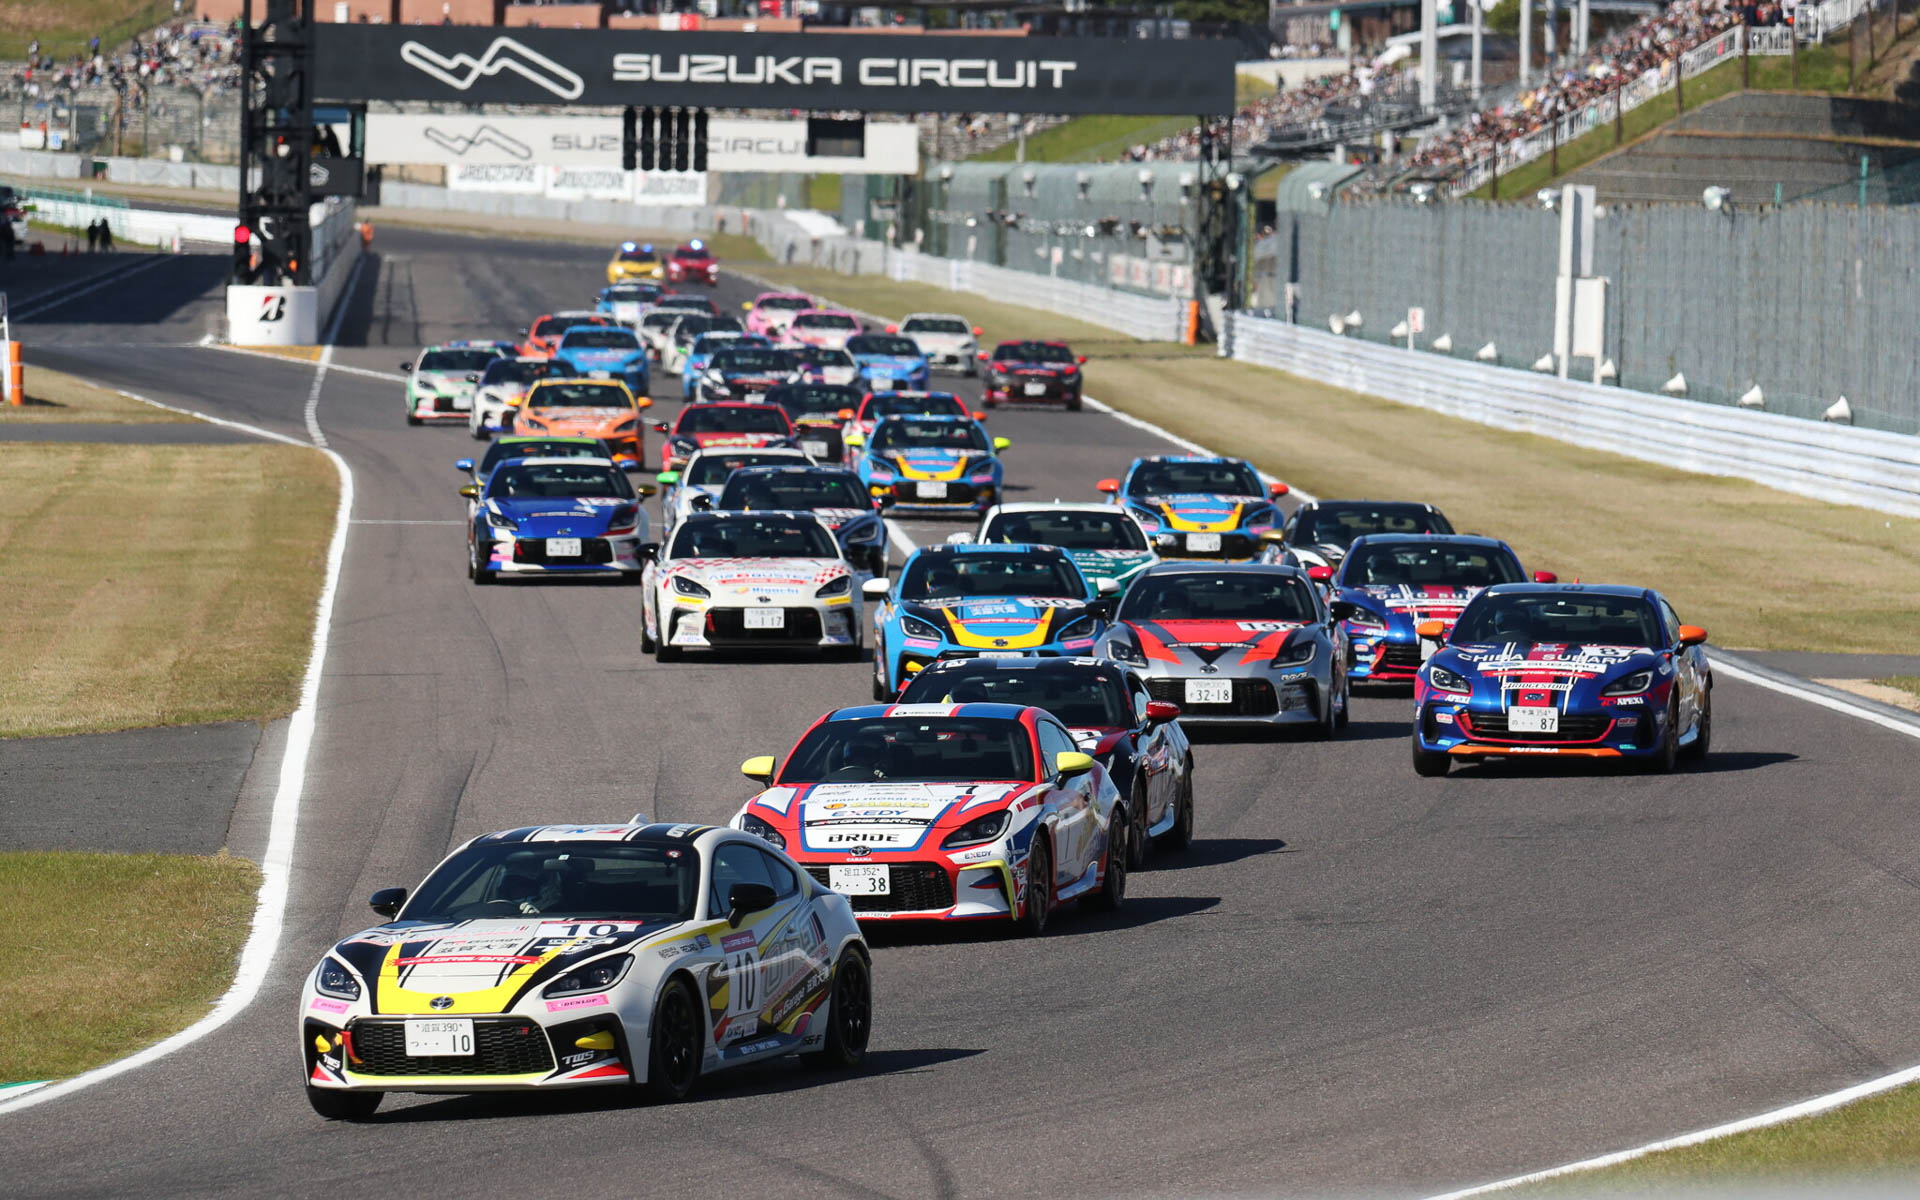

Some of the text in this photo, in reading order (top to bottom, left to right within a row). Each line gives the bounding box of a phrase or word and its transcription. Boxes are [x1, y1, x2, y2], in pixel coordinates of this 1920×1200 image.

[613, 53, 1078, 88] SUZUKA CIRCUIT
[707, 137, 803, 154] CIRCU
[1197, 690, 1230, 701] 32-18
[1540, 718, 1556, 731] 87
[828, 833, 900, 843] BRIDE
[964, 850, 992, 860] EXEDY
[868, 877, 887, 893] 38
[561, 923, 619, 937] 10
[735, 951, 755, 1011] 10
[563, 996, 599, 1007] DUNLOP
[452, 1034, 471, 1052] 10
[562, 1050, 594, 1065] TWS
